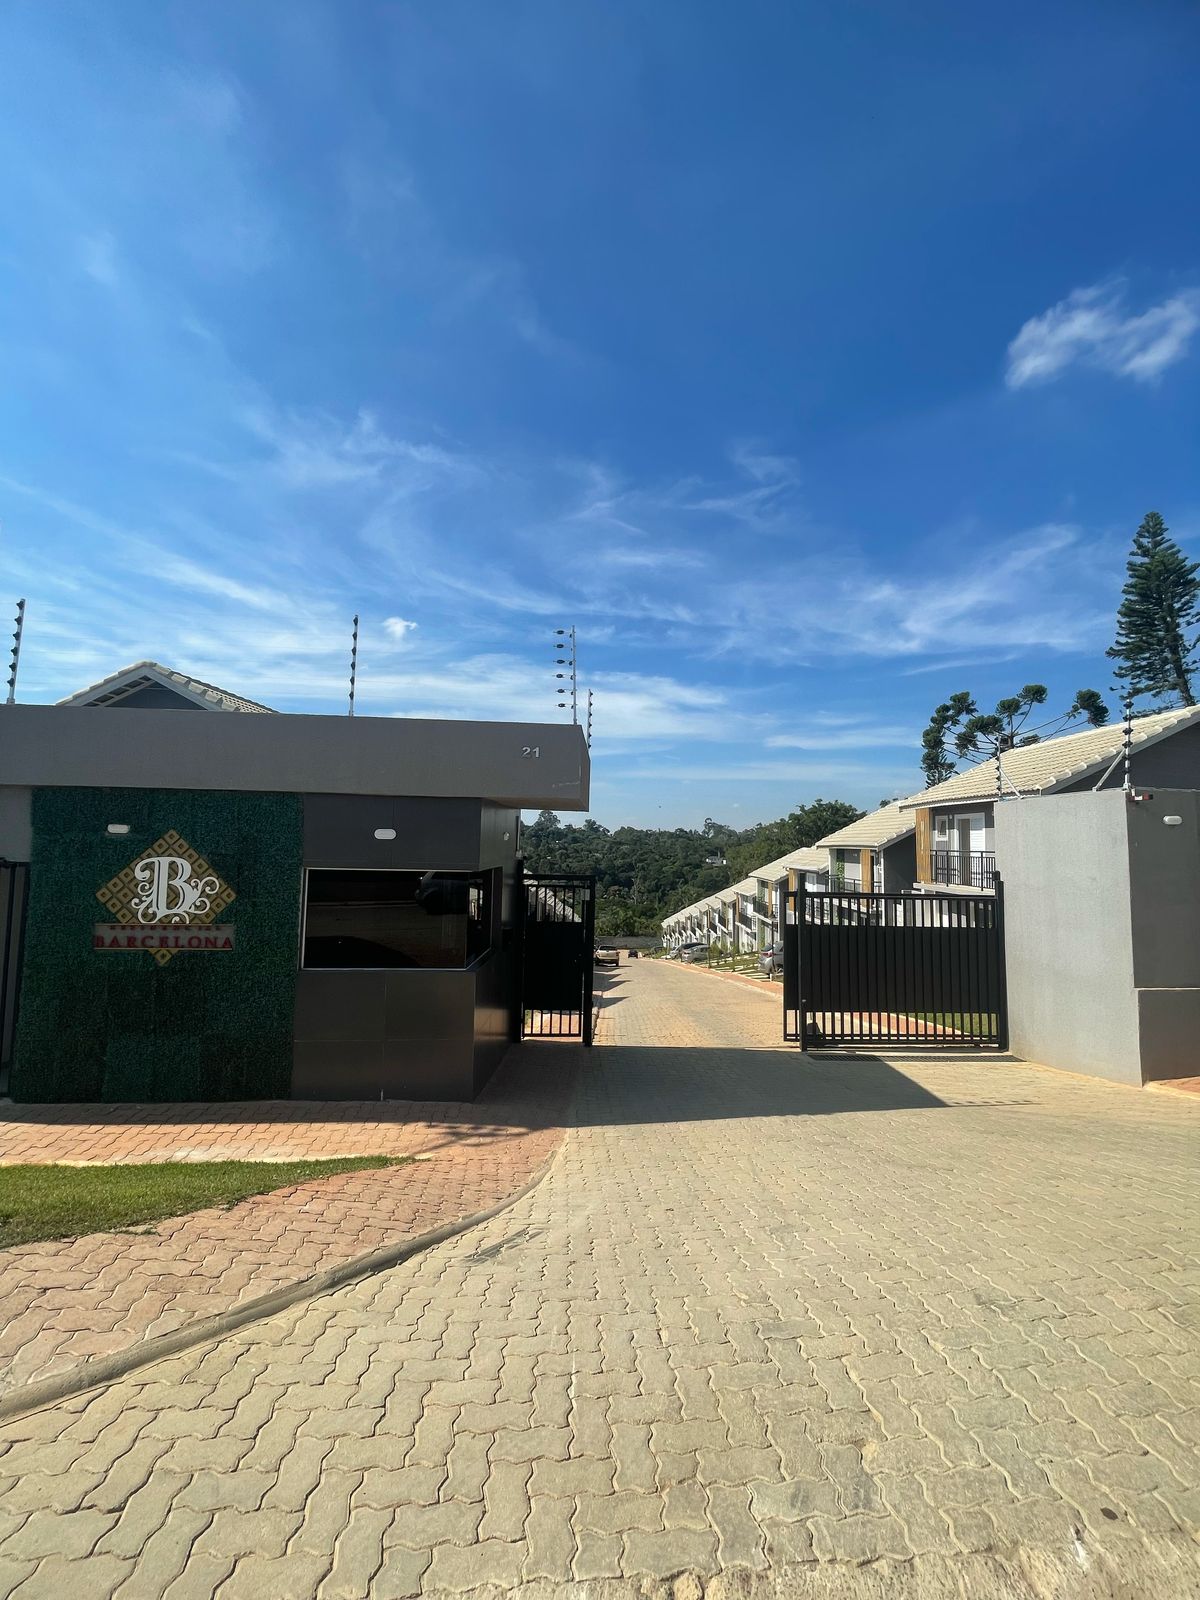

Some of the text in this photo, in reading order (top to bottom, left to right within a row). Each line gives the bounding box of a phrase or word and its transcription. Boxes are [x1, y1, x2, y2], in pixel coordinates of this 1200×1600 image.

[522, 746, 540, 758] 21
[131, 857, 219, 924] B
[95, 935, 233, 949] BARCELONA
